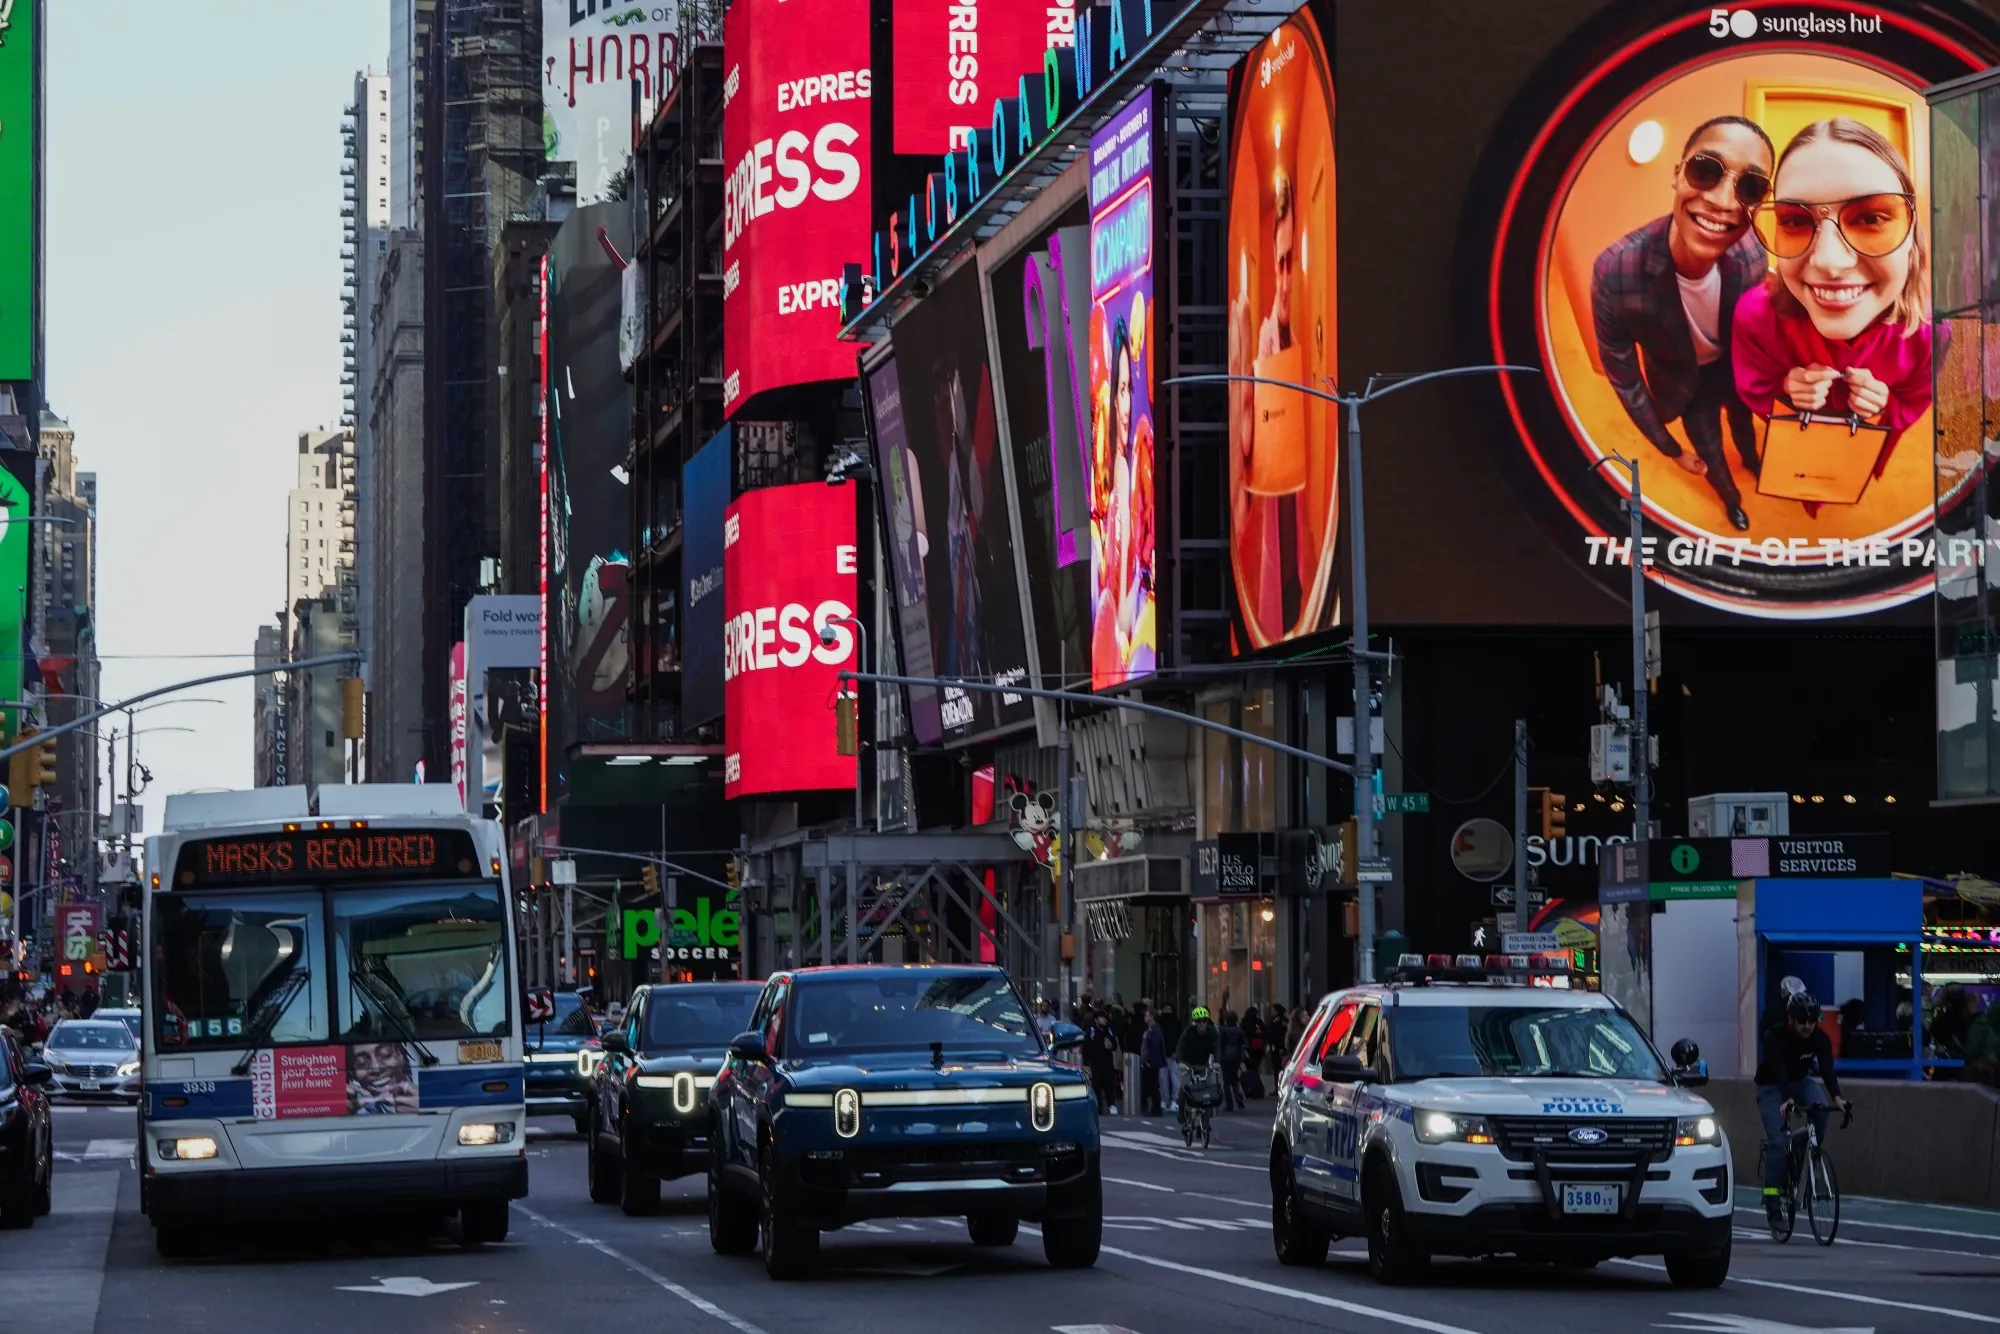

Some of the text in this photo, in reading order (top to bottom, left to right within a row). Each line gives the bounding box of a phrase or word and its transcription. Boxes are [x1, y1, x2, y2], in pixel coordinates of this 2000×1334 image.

[651, 8, 673, 22] OF
[1762, 12, 1846, 38] sunglass
[1850, 12, 1883, 34] hut
[949, 0, 978, 105] RESS
[568, 31, 706, 108] HORR
[724, 122, 861, 251] EXPRESS
[1095, 190, 1148, 287] COMPANY
[1584, 536, 1658, 566] THE
[1667, 536, 1753, 567] GIFT
[1759, 536, 1812, 567] OF
[1817, 537, 1891, 567] THE
[483, 609, 512, 623] Fold
[724, 600, 854, 682] EXPRESS
[276, 669, 287, 787] WELLINGTON
[1387, 795, 1398, 811] W
[1402, 795, 1416, 812] 45
[206, 834, 436, 874] MASKS REQUIRED
[1779, 841, 1844, 854] VISITOR
[1222, 865, 1254, 876] POLO
[1779, 859, 1857, 873] SERVICES
[1222, 875, 1257, 887] ASSN.
[65, 909, 93, 961] tkts
[650, 947, 729, 961] SOCCER
[281, 1054, 337, 1067] Straighten
[281, 1065, 338, 1080] your teeth
[183, 1081, 216, 1094] 3938
[261, 1053, 272, 1118] CANDID
[282, 1078, 332, 1092] from home
[1542, 1103, 1624, 1114] POLICE
[1326, 1113, 1357, 1160] NYPD
[1567, 1191, 1601, 1206] 3580
